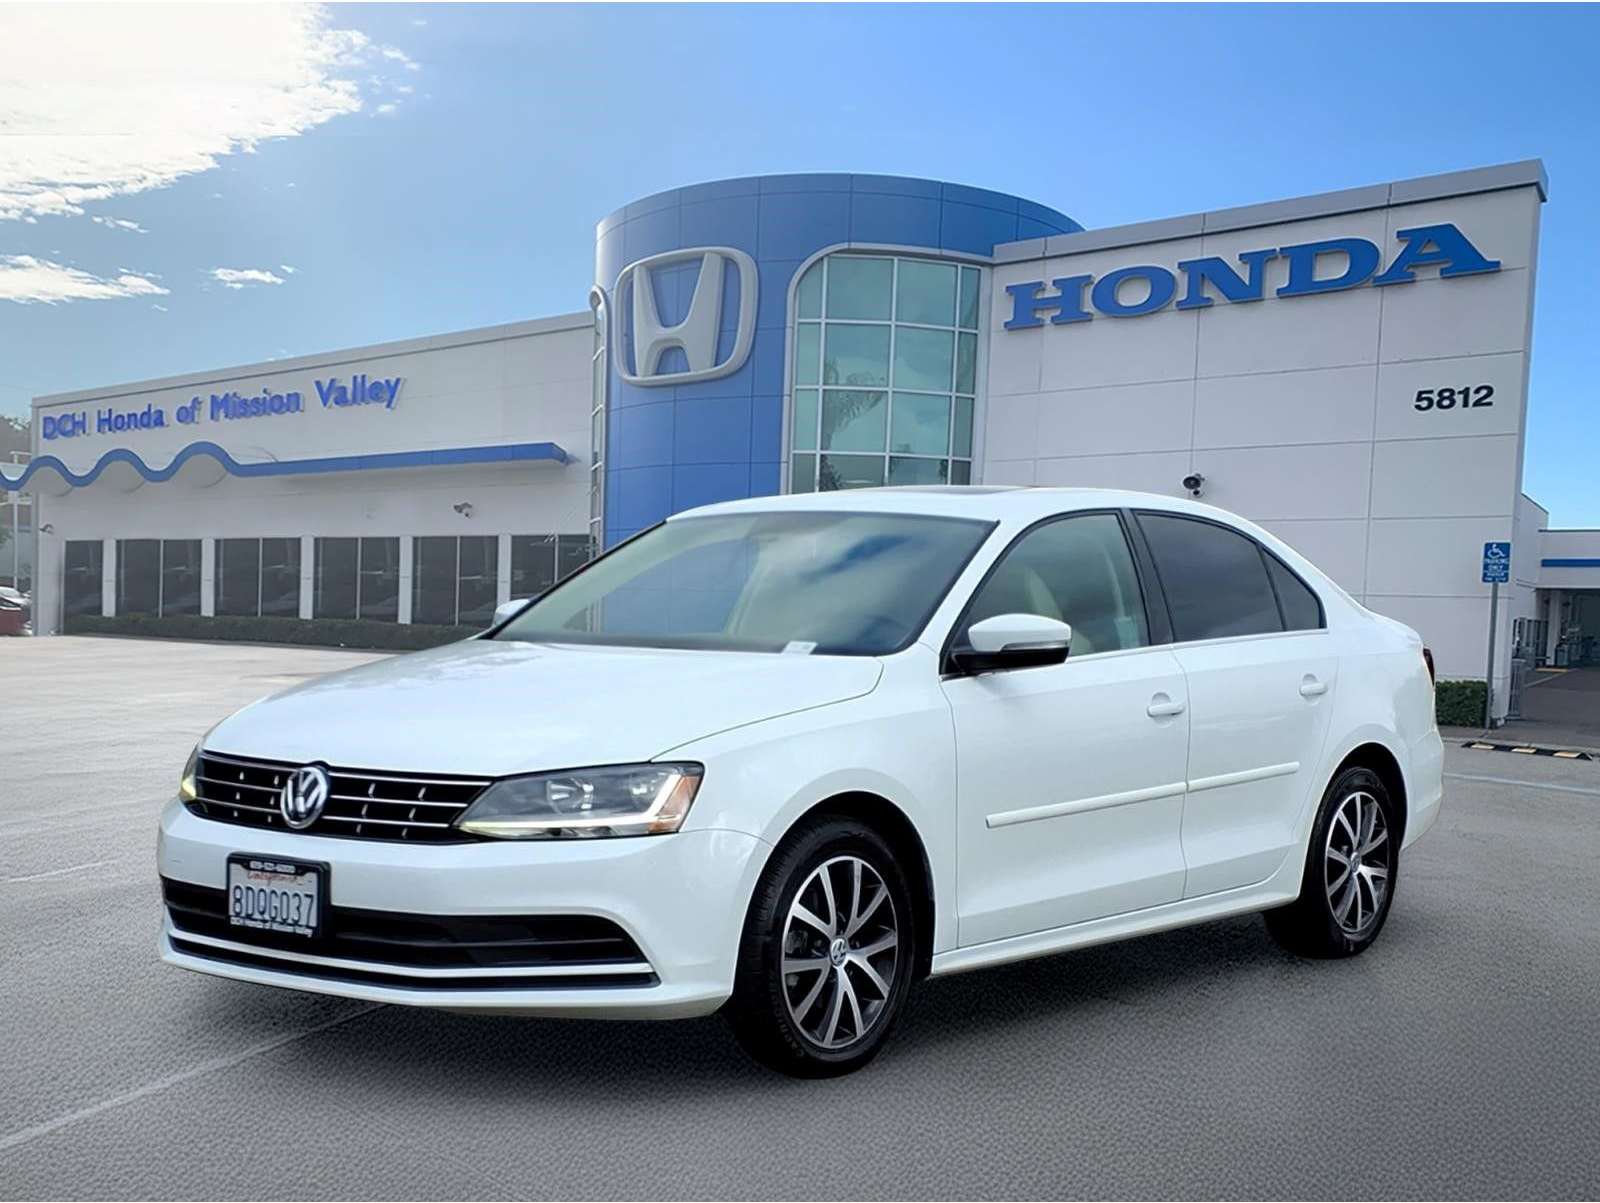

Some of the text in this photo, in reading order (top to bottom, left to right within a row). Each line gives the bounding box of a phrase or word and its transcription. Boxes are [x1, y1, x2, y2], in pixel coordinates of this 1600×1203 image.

[1004, 223, 1501, 330] HONDA
[42, 374, 404, 440] DCH Honda of Mission Valley
[1414, 385, 1494, 411] 5812
